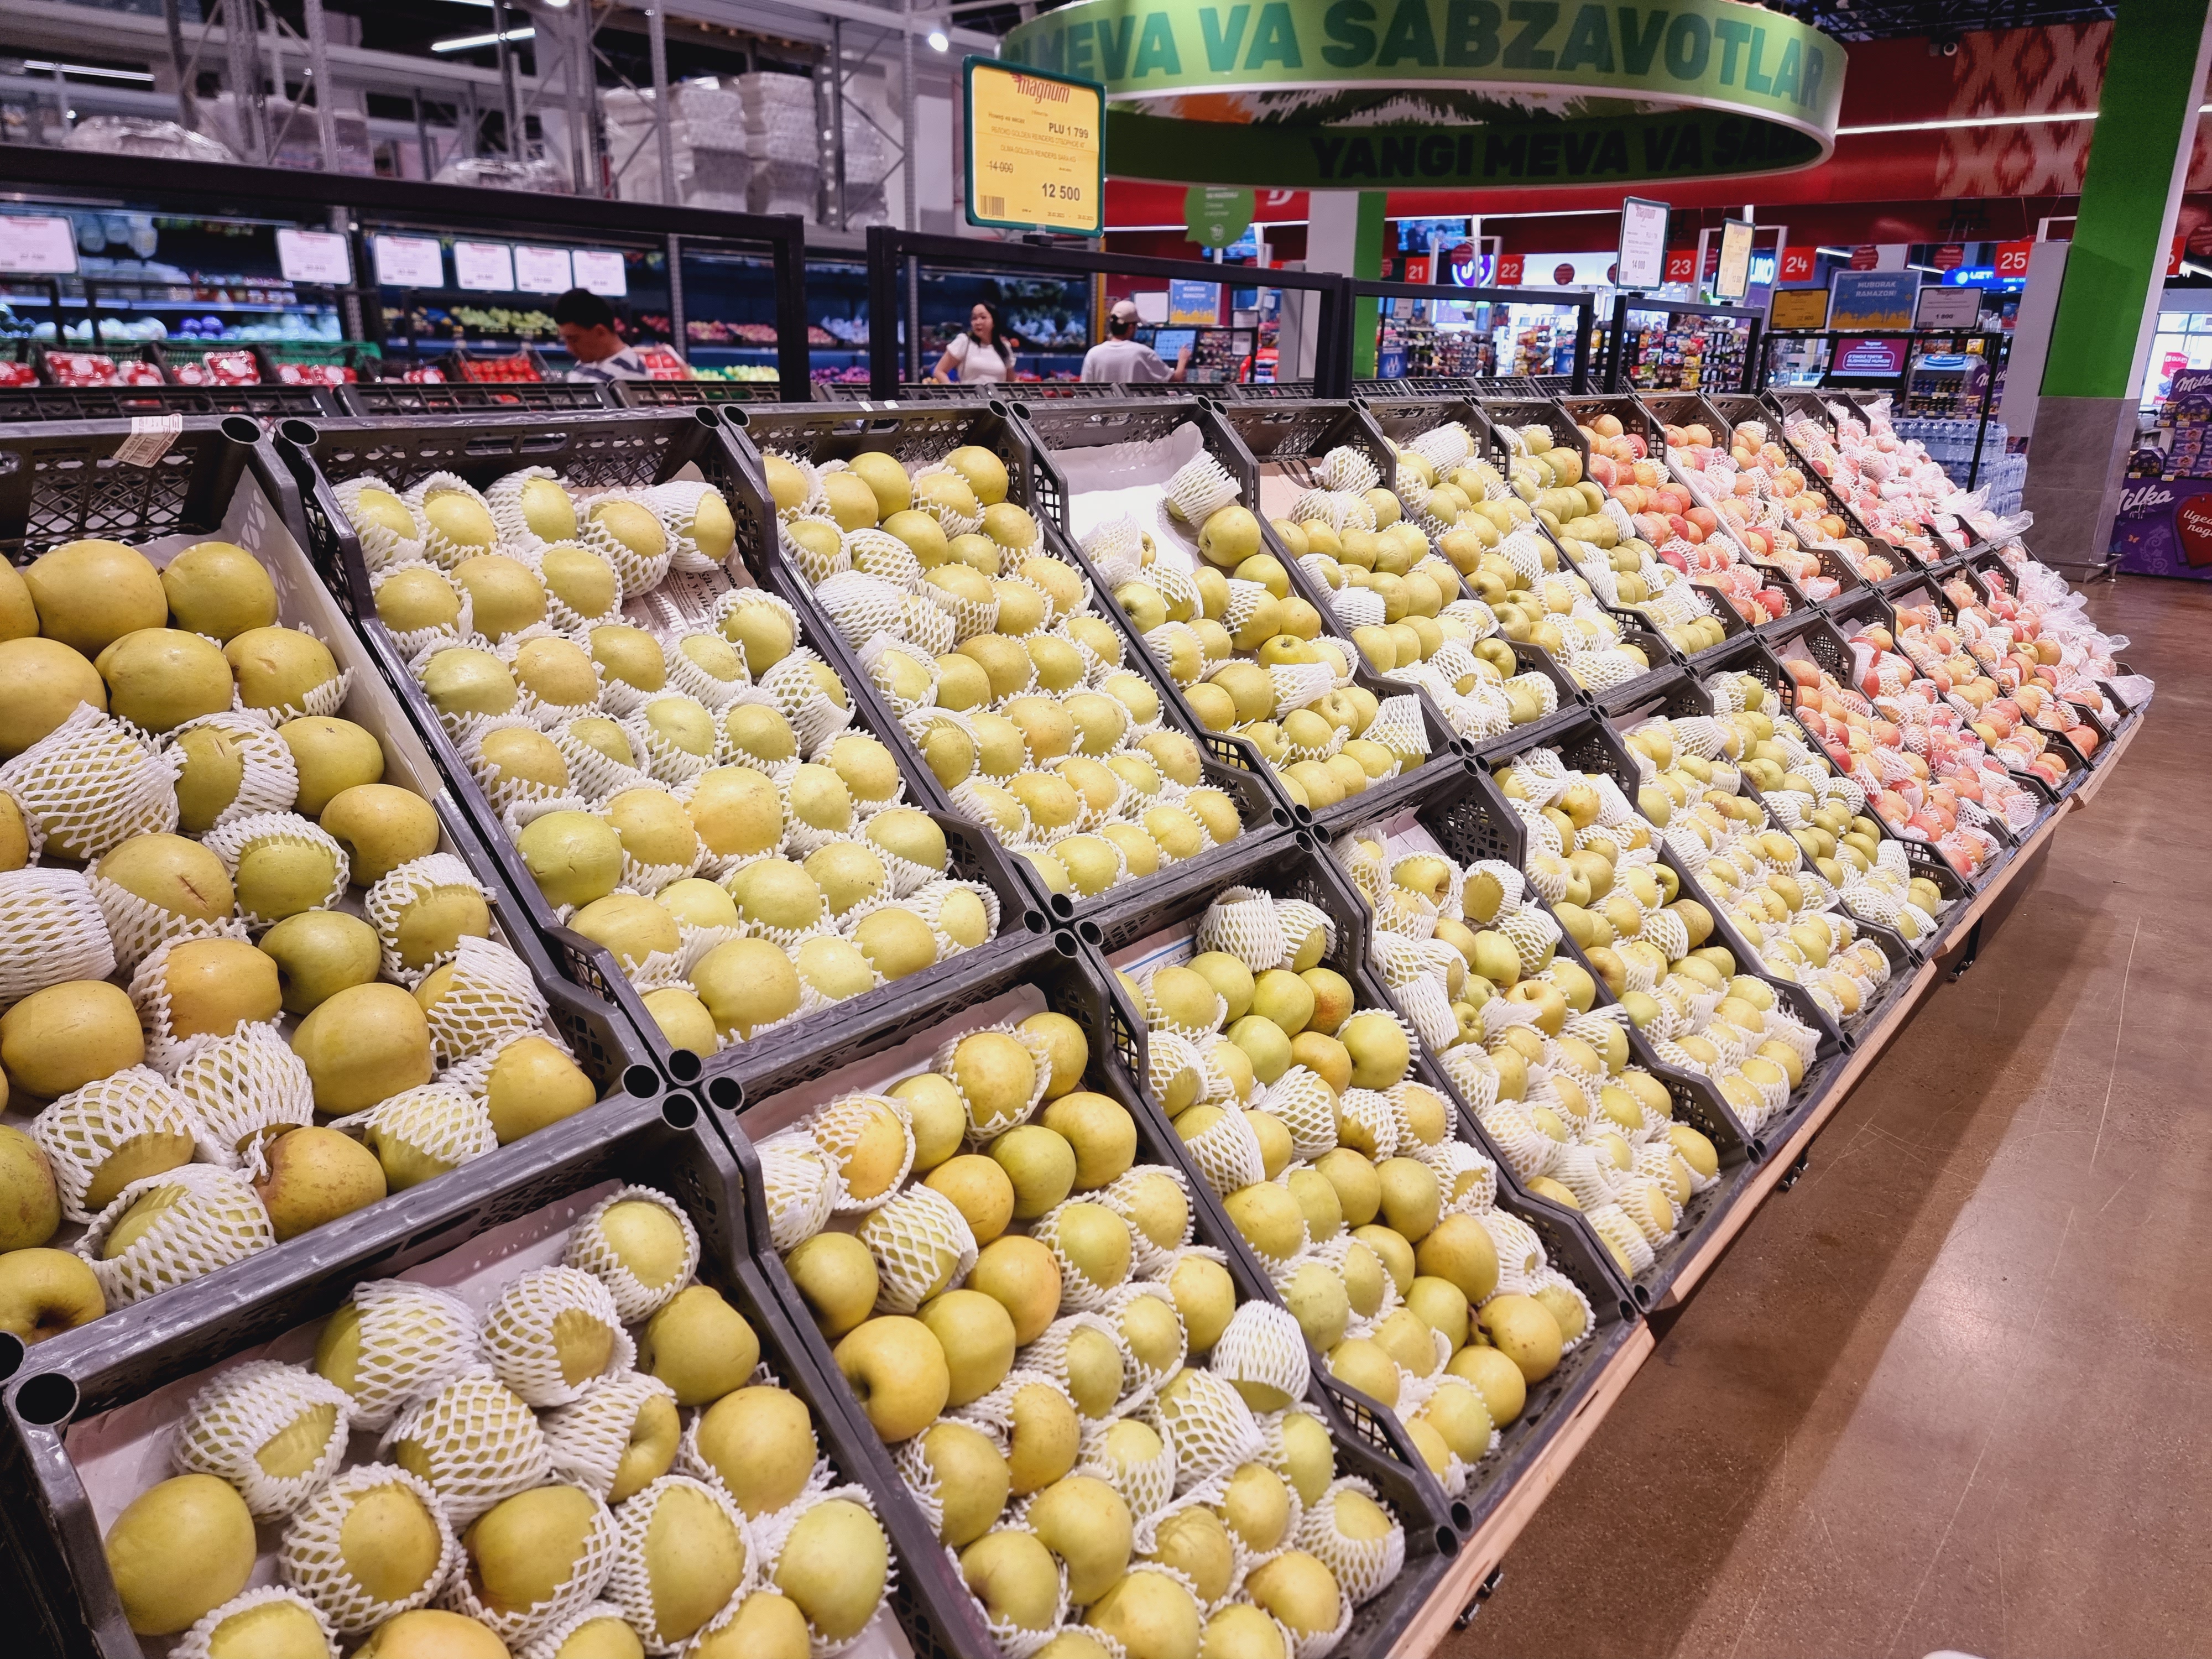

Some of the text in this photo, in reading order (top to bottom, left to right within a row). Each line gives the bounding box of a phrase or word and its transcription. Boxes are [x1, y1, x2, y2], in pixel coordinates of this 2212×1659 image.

[1037, 12, 1182, 81] MEVA
[1199, 3, 1303, 74] VA
[1321, 0, 1823, 108] SABZAVOTLAR
[1016, 76, 1071, 104] magnum
[1048, 122, 1089, 139] PLU 1 799
[1310, 134, 1474, 179] YANGI
[1484, 130, 1629, 178] MEVA
[1643, 123, 1703, 172] VA
[1042, 182, 1081, 201] 12 500
[1670, 259, 1692, 275] 23
[1785, 256, 1808, 273] 24
[2000, 252, 2026, 270] 25
[1408, 265, 1423, 280] 21
[1500, 263, 1519, 278] 22
